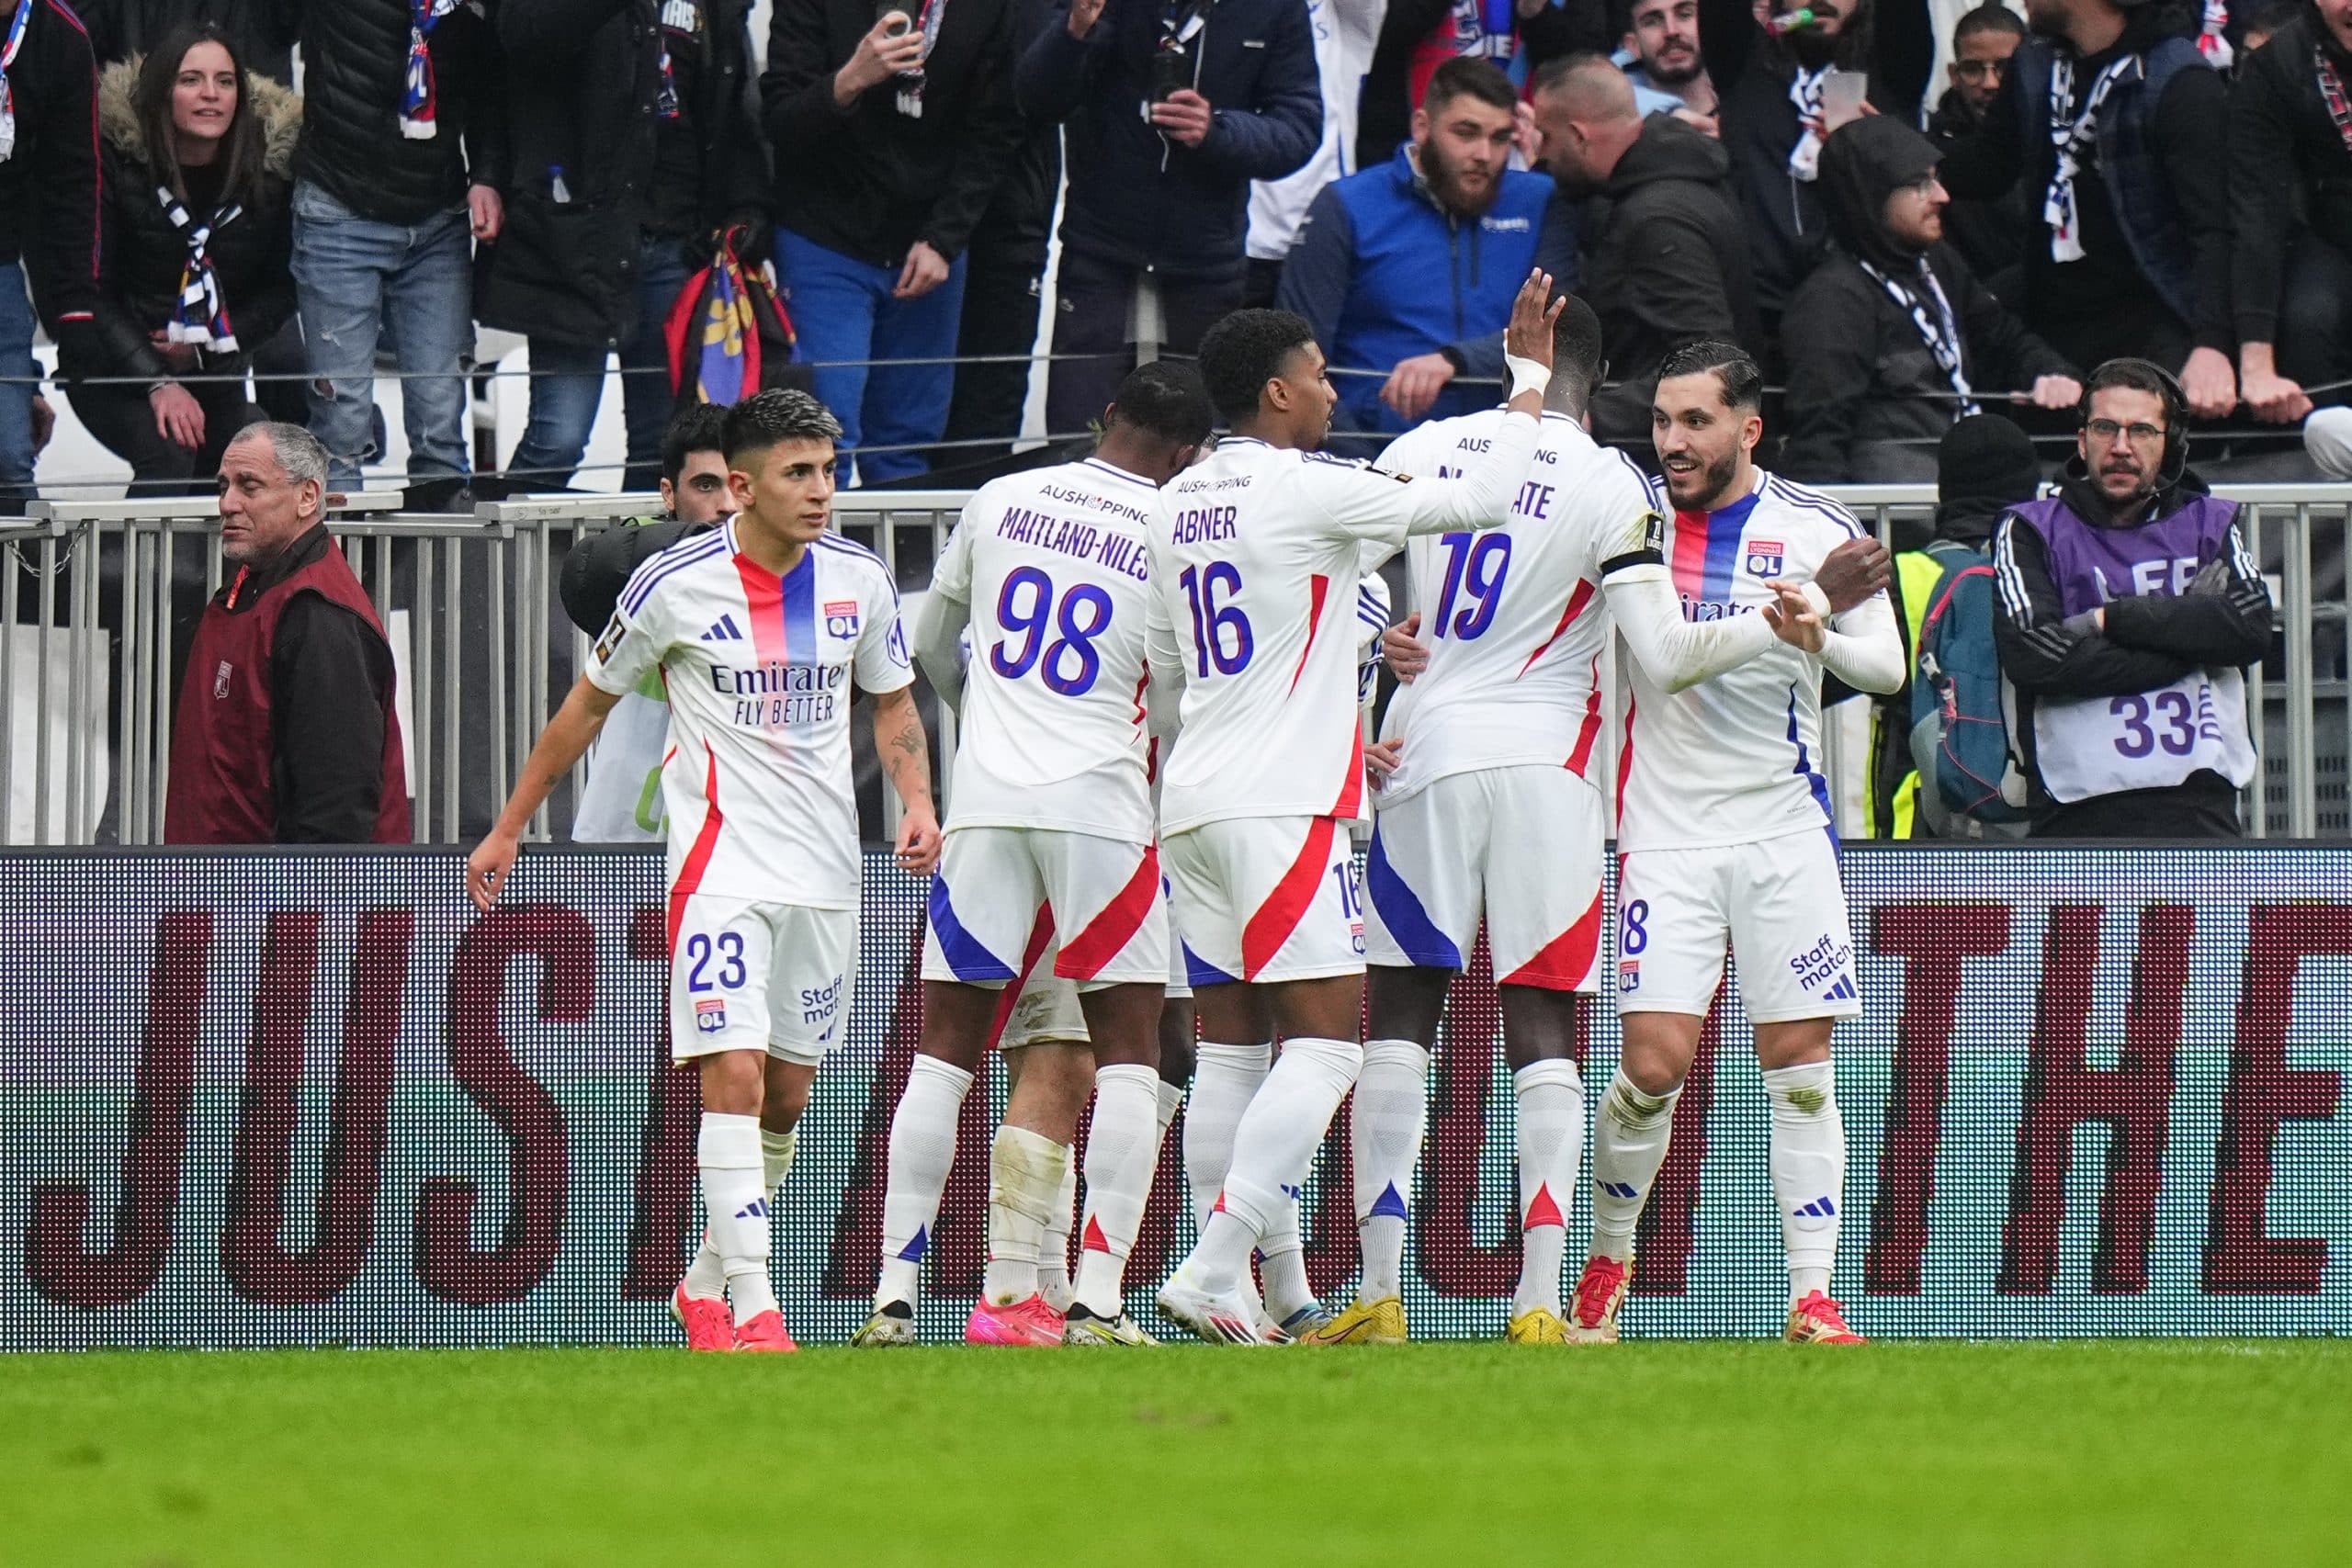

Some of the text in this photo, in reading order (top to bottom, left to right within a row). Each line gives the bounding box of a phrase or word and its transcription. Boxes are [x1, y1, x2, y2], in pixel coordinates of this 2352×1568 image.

[997, 506, 1148, 581] MAITLAND-NILES
[1172, 505, 1237, 545] ABNER
[1434, 532, 1512, 641] 19
[1749, 556, 1779, 574] OL
[830, 616, 857, 636] OL
[990, 566, 1114, 697] 98
[1180, 561, 1255, 678] 16
[735, 695, 833, 726] FLY BETTER
[2109, 691, 2197, 760] 33
[1618, 898, 1649, 958] 18
[1790, 933, 1834, 975] Staff
[687, 931, 747, 993] 23
[1799, 943, 1852, 991] match
[802, 974, 843, 1007] Staff
[804, 998, 840, 1025] mat
[26, 903, 705, 1307] JUST
[1863, 904, 2352, 1296] THE
